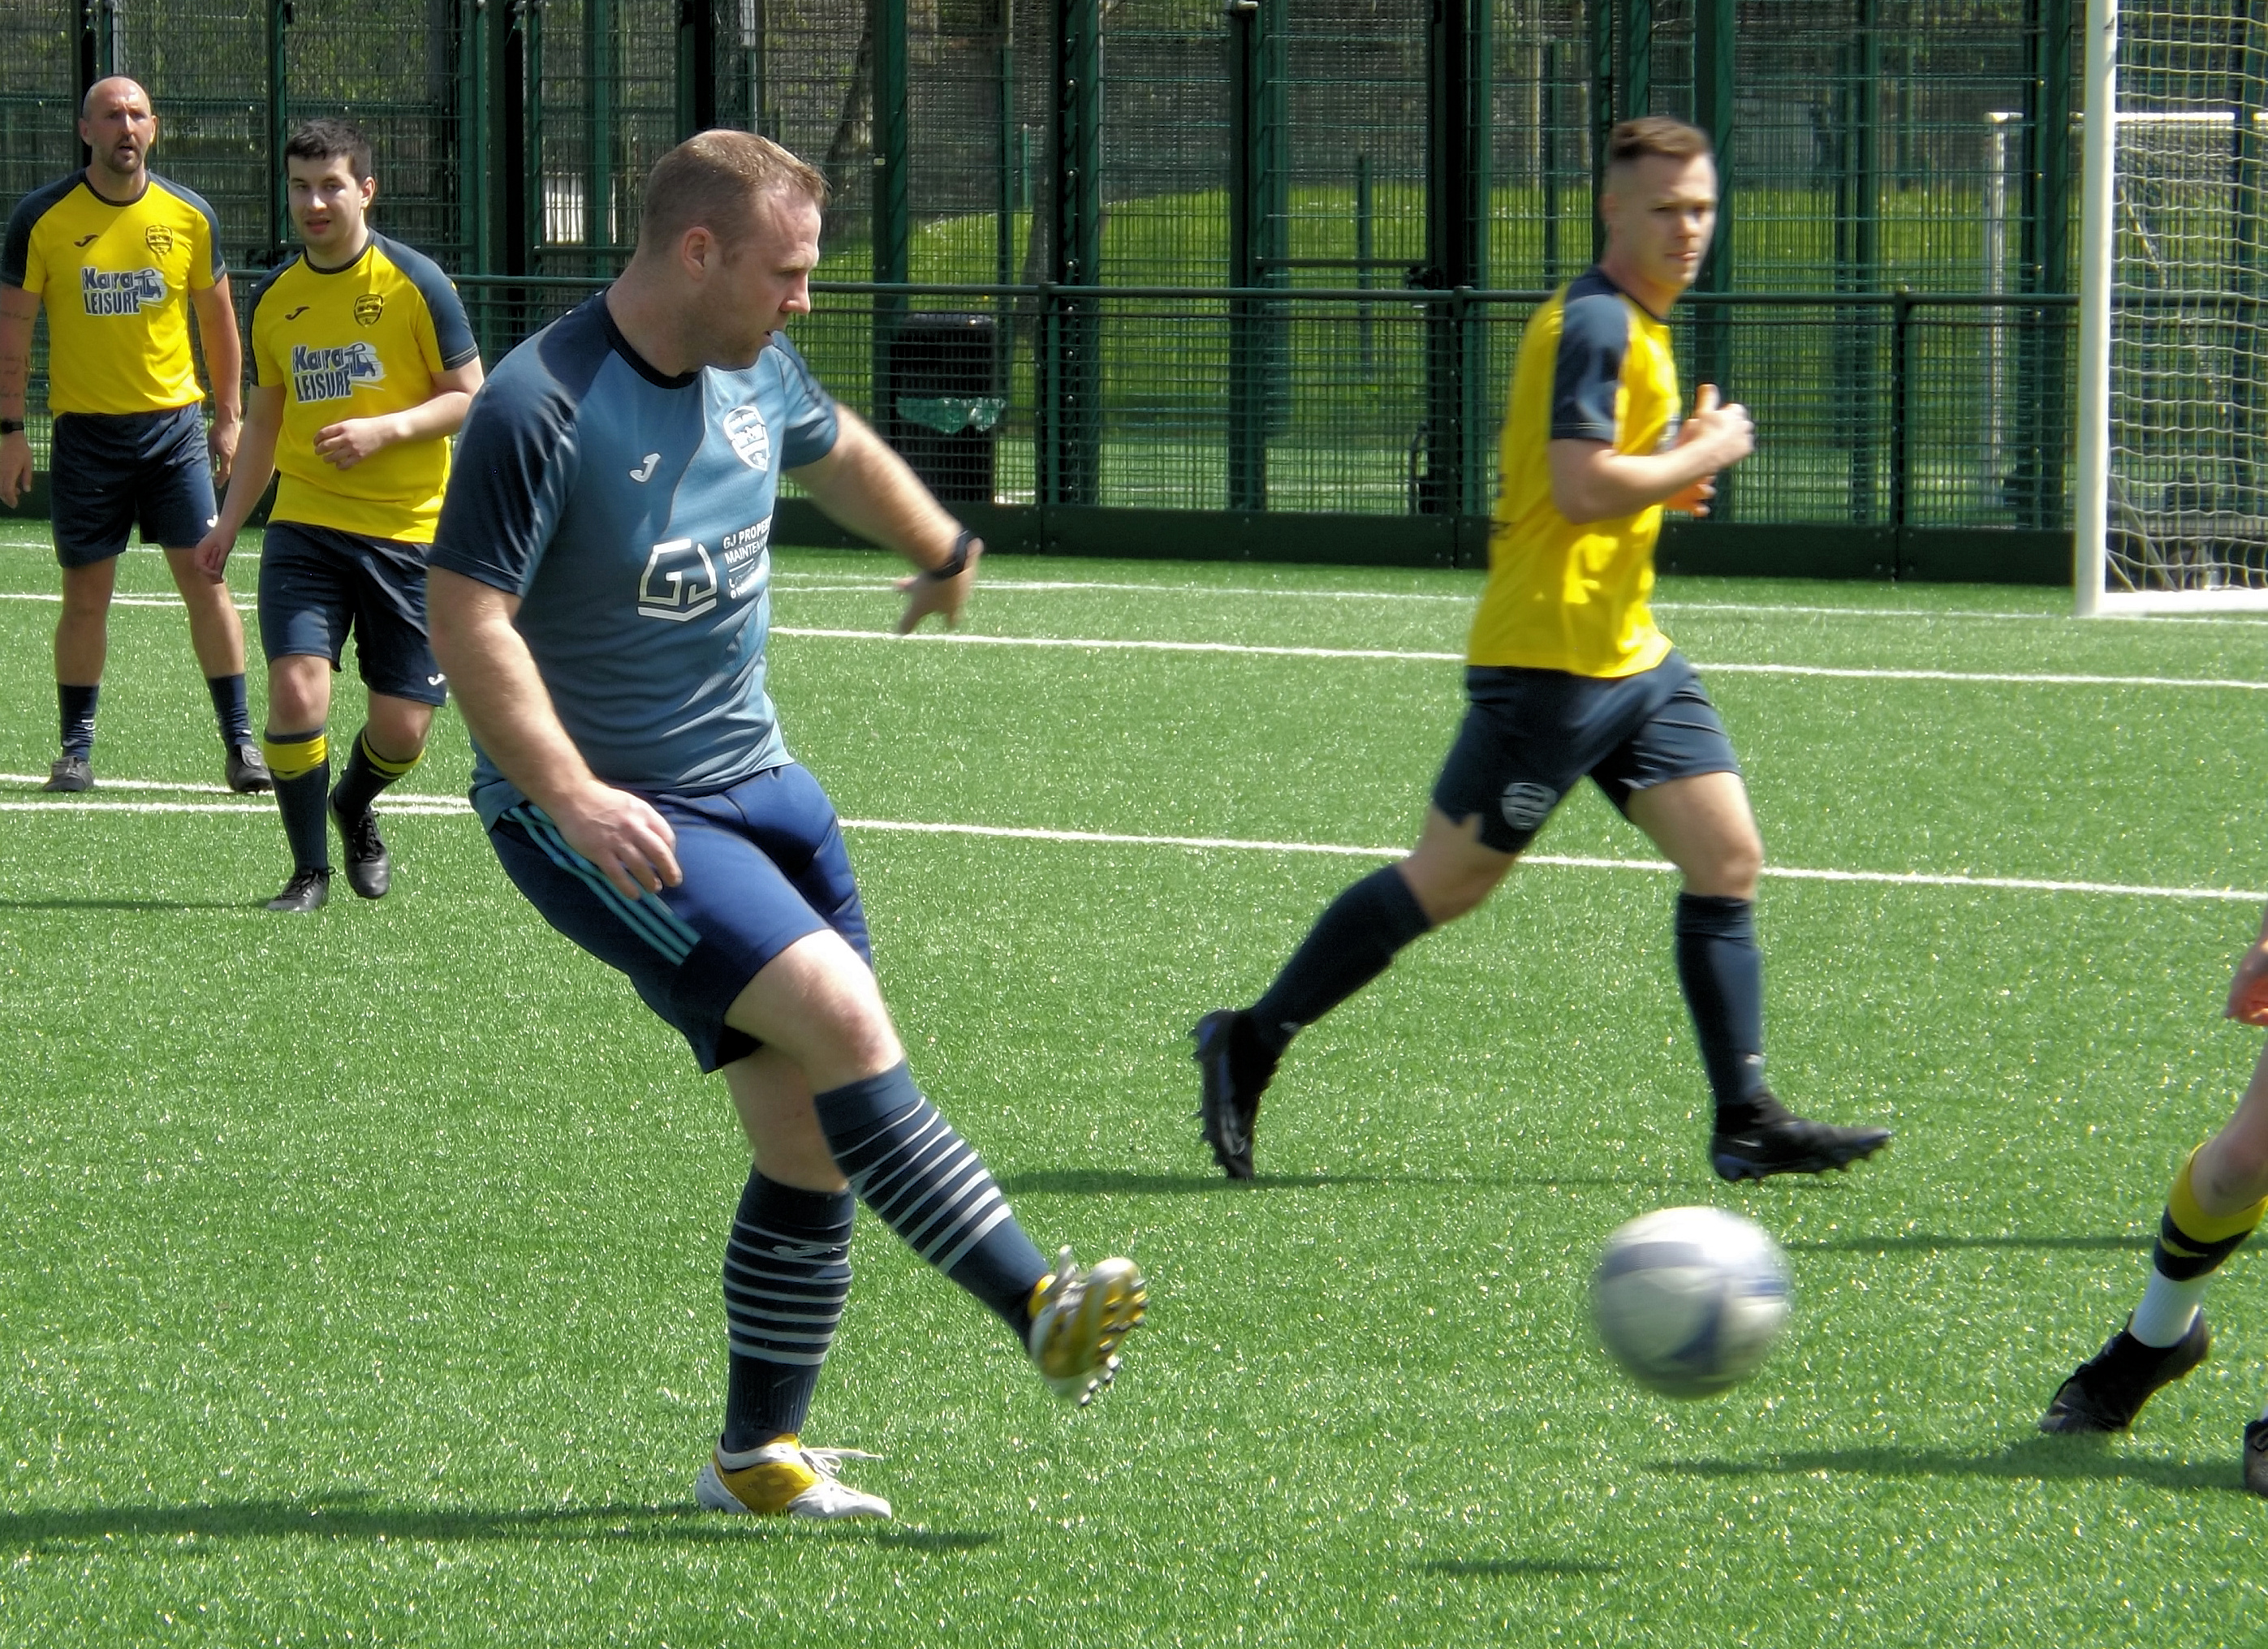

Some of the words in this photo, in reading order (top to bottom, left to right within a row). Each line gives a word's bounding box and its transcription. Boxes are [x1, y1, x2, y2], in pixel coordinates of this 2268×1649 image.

[82, 267, 134, 291] Kara
[84, 291, 140, 315] LEISURE
[292, 345, 344, 373] Kara
[295, 369, 352, 403] LEISURE
[723, 534, 737, 550] GJ
